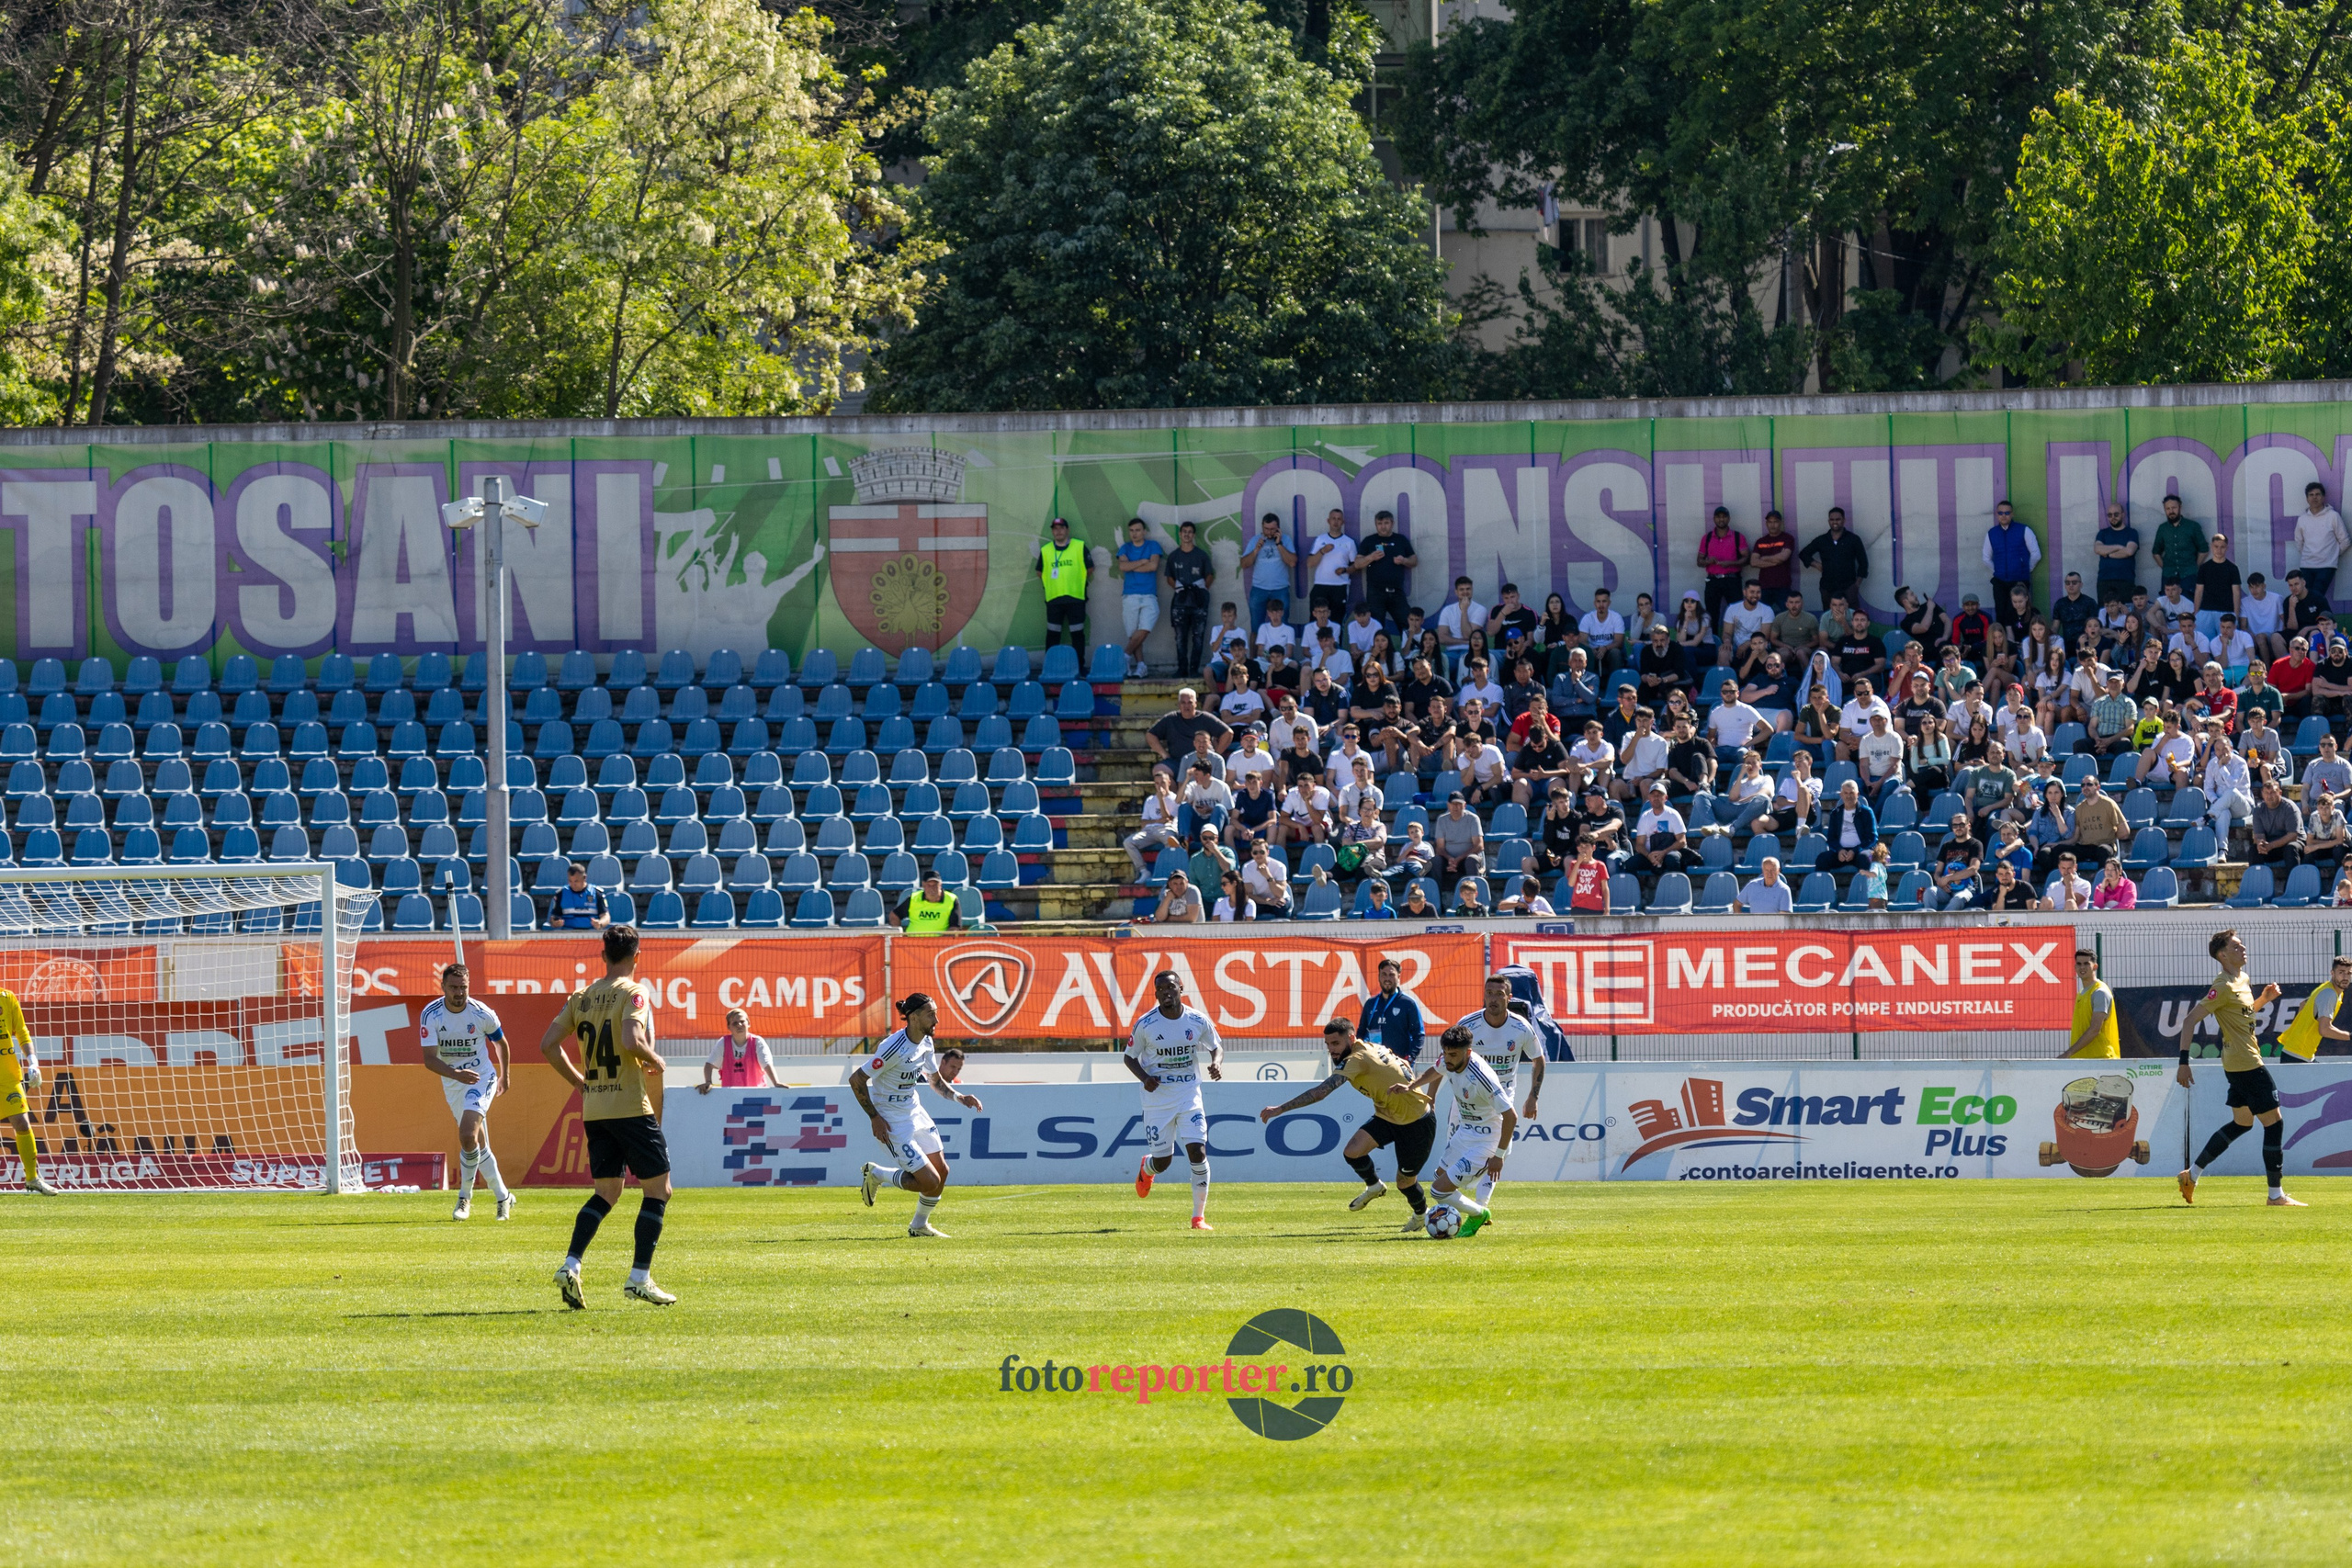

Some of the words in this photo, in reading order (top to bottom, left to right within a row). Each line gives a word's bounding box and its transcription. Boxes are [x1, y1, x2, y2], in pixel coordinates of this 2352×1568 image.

[1577, 869, 1598, 877] TODAY
[1576, 883, 1595, 894] DAY
[1667, 942, 2061, 988] MECANEX
[1039, 949, 1450, 1027] AVASTAR
[718, 976, 865, 1019] CAMPS
[1712, 1000, 1829, 1018] PRODUCĂTOR
[1833, 1001, 1891, 1016] POMPE
[1894, 1000, 2014, 1016] INDUSTRIALE
[577, 1019, 622, 1080] 24
[1156, 1045, 1196, 1056] UNIBET
[1483, 1055, 1517, 1065] NIBET
[1733, 1087, 1905, 1126] Smart
[1917, 1087, 2017, 1125] Eco
[1146, 1125, 1159, 1141] 83
[902, 1144, 916, 1158] 8
[1925, 1129, 2007, 1156] Plus
[1689, 1162, 1959, 1180] contoareinteligente.ro
